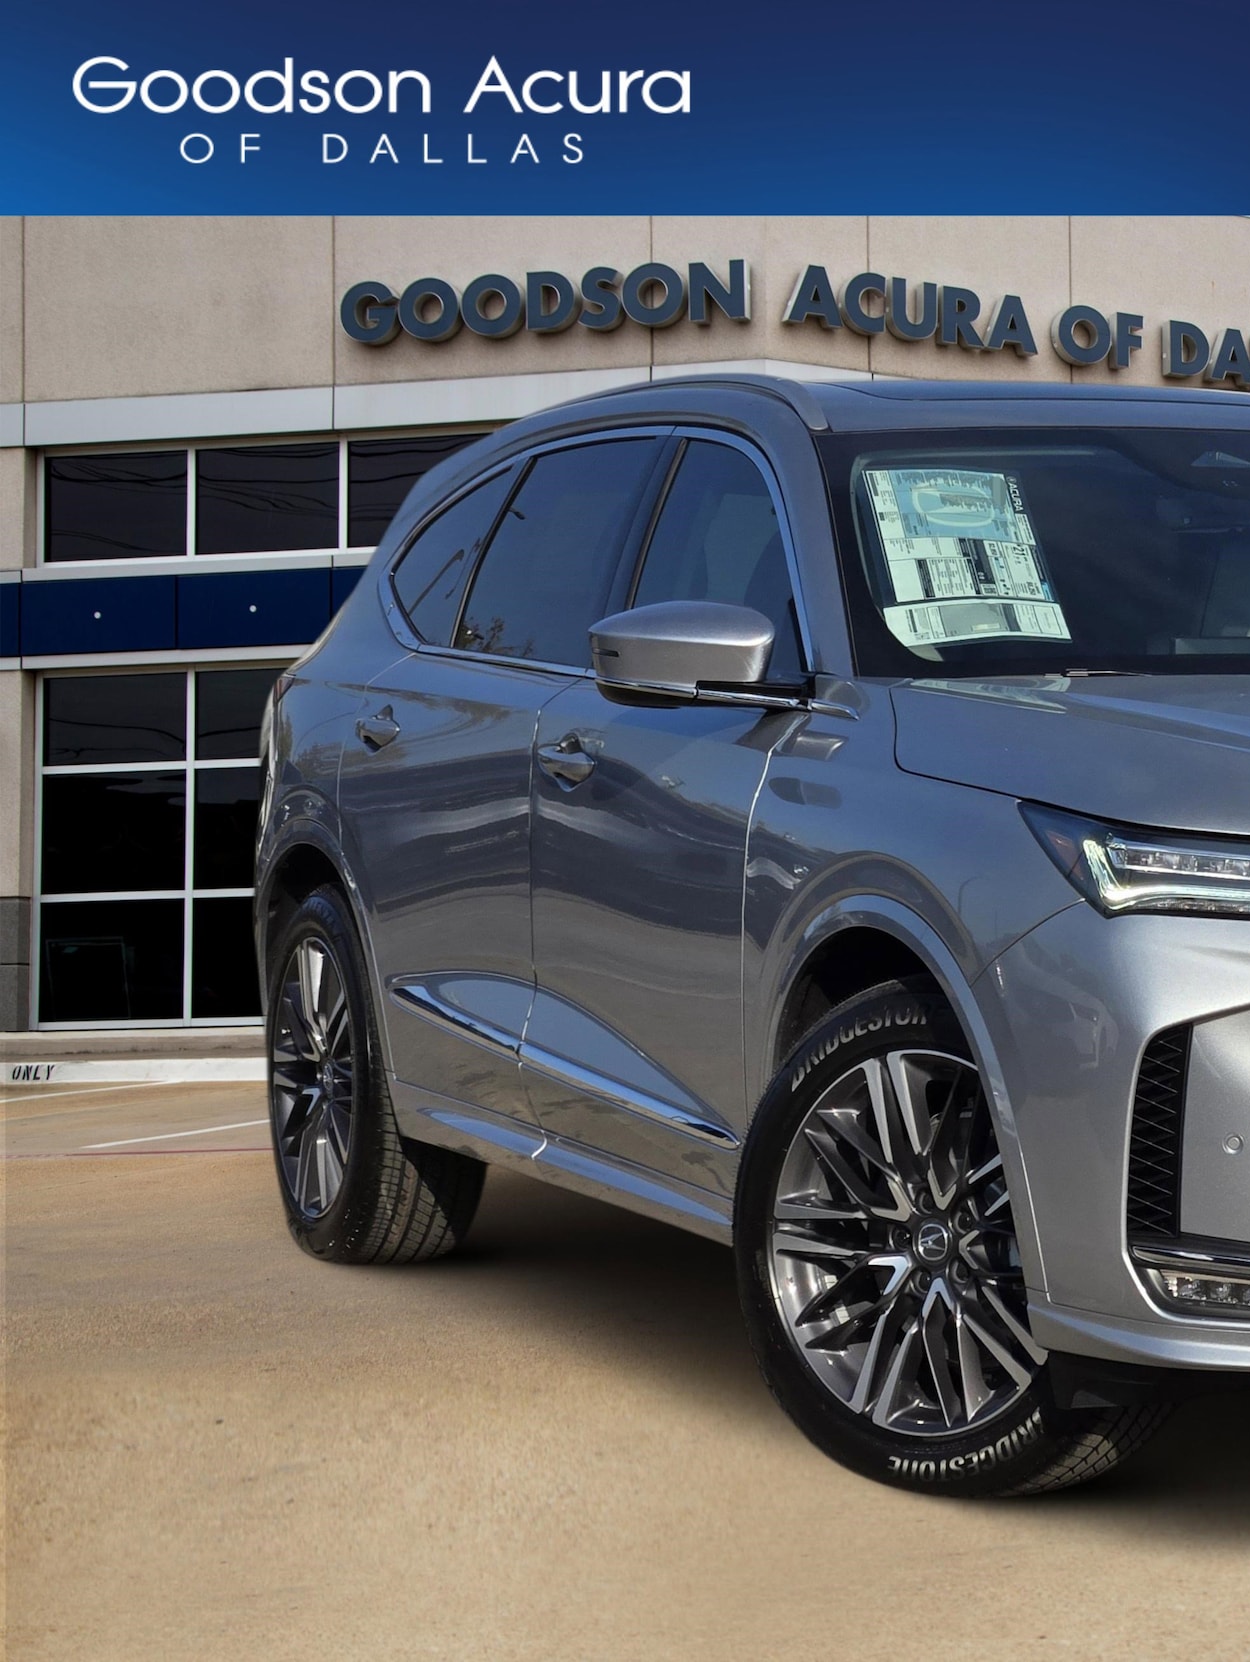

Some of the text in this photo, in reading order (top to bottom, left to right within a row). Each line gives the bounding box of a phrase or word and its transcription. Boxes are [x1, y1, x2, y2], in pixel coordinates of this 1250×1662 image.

[340, 258, 750, 346] GOODSON
[782, 264, 1037, 357] ACURA
[1051, 305, 1143, 370] OF
[1008, 482, 1023, 511] ACURA
[12, 1064, 55, 1080] ONLY
